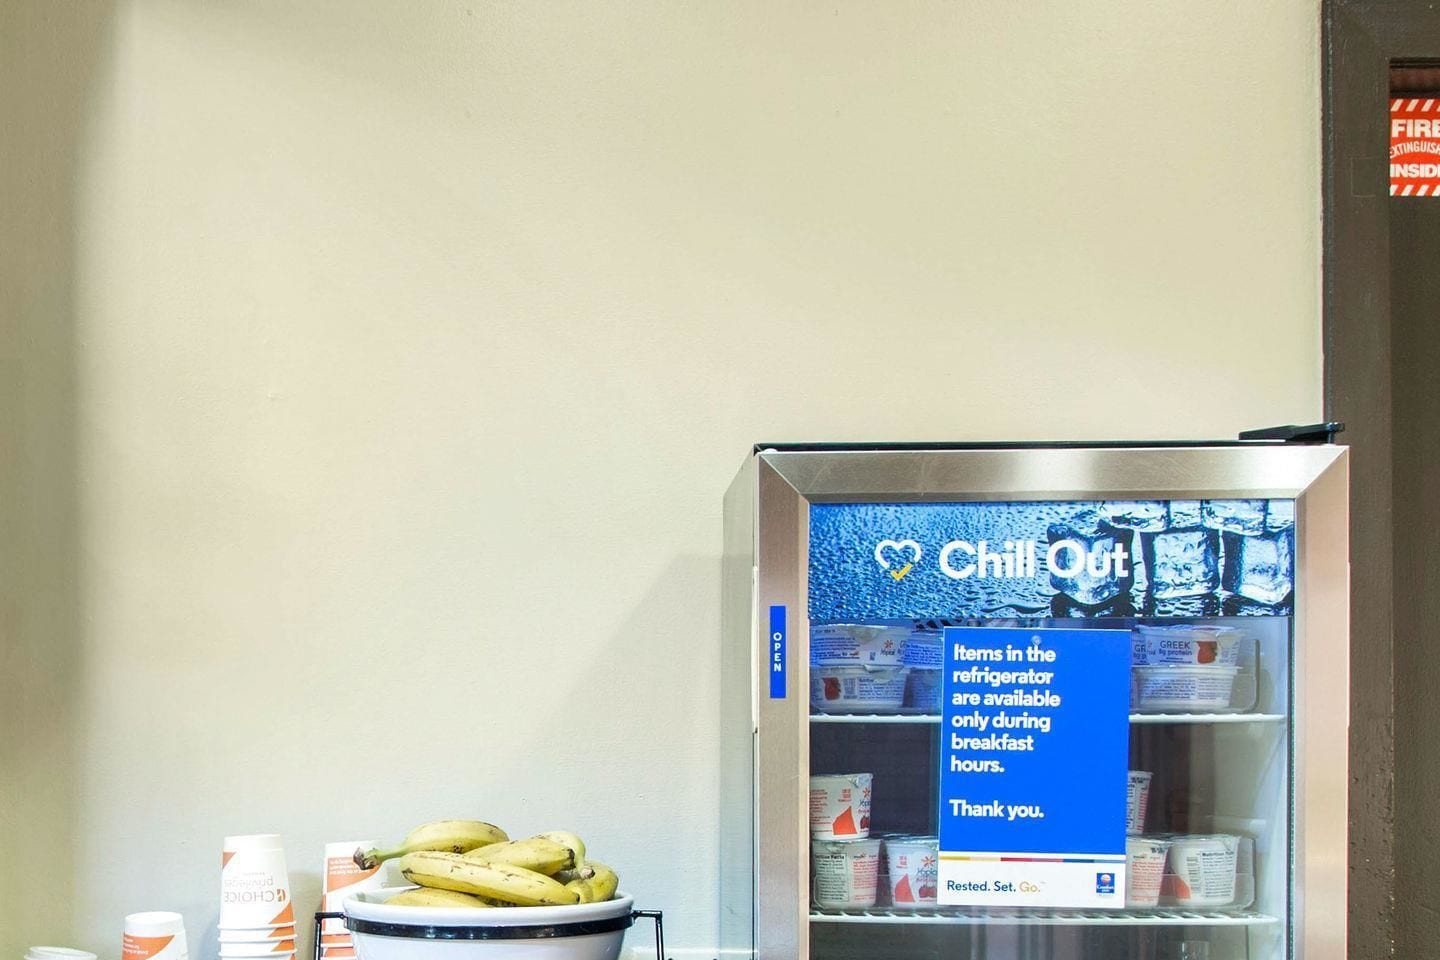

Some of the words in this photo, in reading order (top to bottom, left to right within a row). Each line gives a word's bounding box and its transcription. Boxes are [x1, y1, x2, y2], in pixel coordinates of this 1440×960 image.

[1392, 119, 1440, 138] FIRE
[1390, 163, 1440, 178] INSID
[939, 540, 1035, 579] Chill
[1046, 540, 1129, 579] Out
[773, 632, 782, 672] OPEN
[953, 644, 1003, 662] Items
[1006, 645, 1023, 662] in
[1026, 645, 1057, 662] the
[1160, 640, 1191, 649] GREEK
[952, 666, 1054, 687] refrigerator
[952, 692, 981, 706] are
[984, 689, 1061, 707] available
[951, 711, 990, 731] only
[992, 711, 1051, 732] during
[951, 733, 1034, 751] breakfast
[950, 755, 1005, 773] hours.
[949, 799, 1004, 817] Thank
[1007, 804, 1045, 821] you.
[947, 880, 990, 892] Rested.
[993, 881, 1016, 892] Set.
[1019, 881, 1041, 893] Go.
[224, 890, 275, 903] CHOICE
